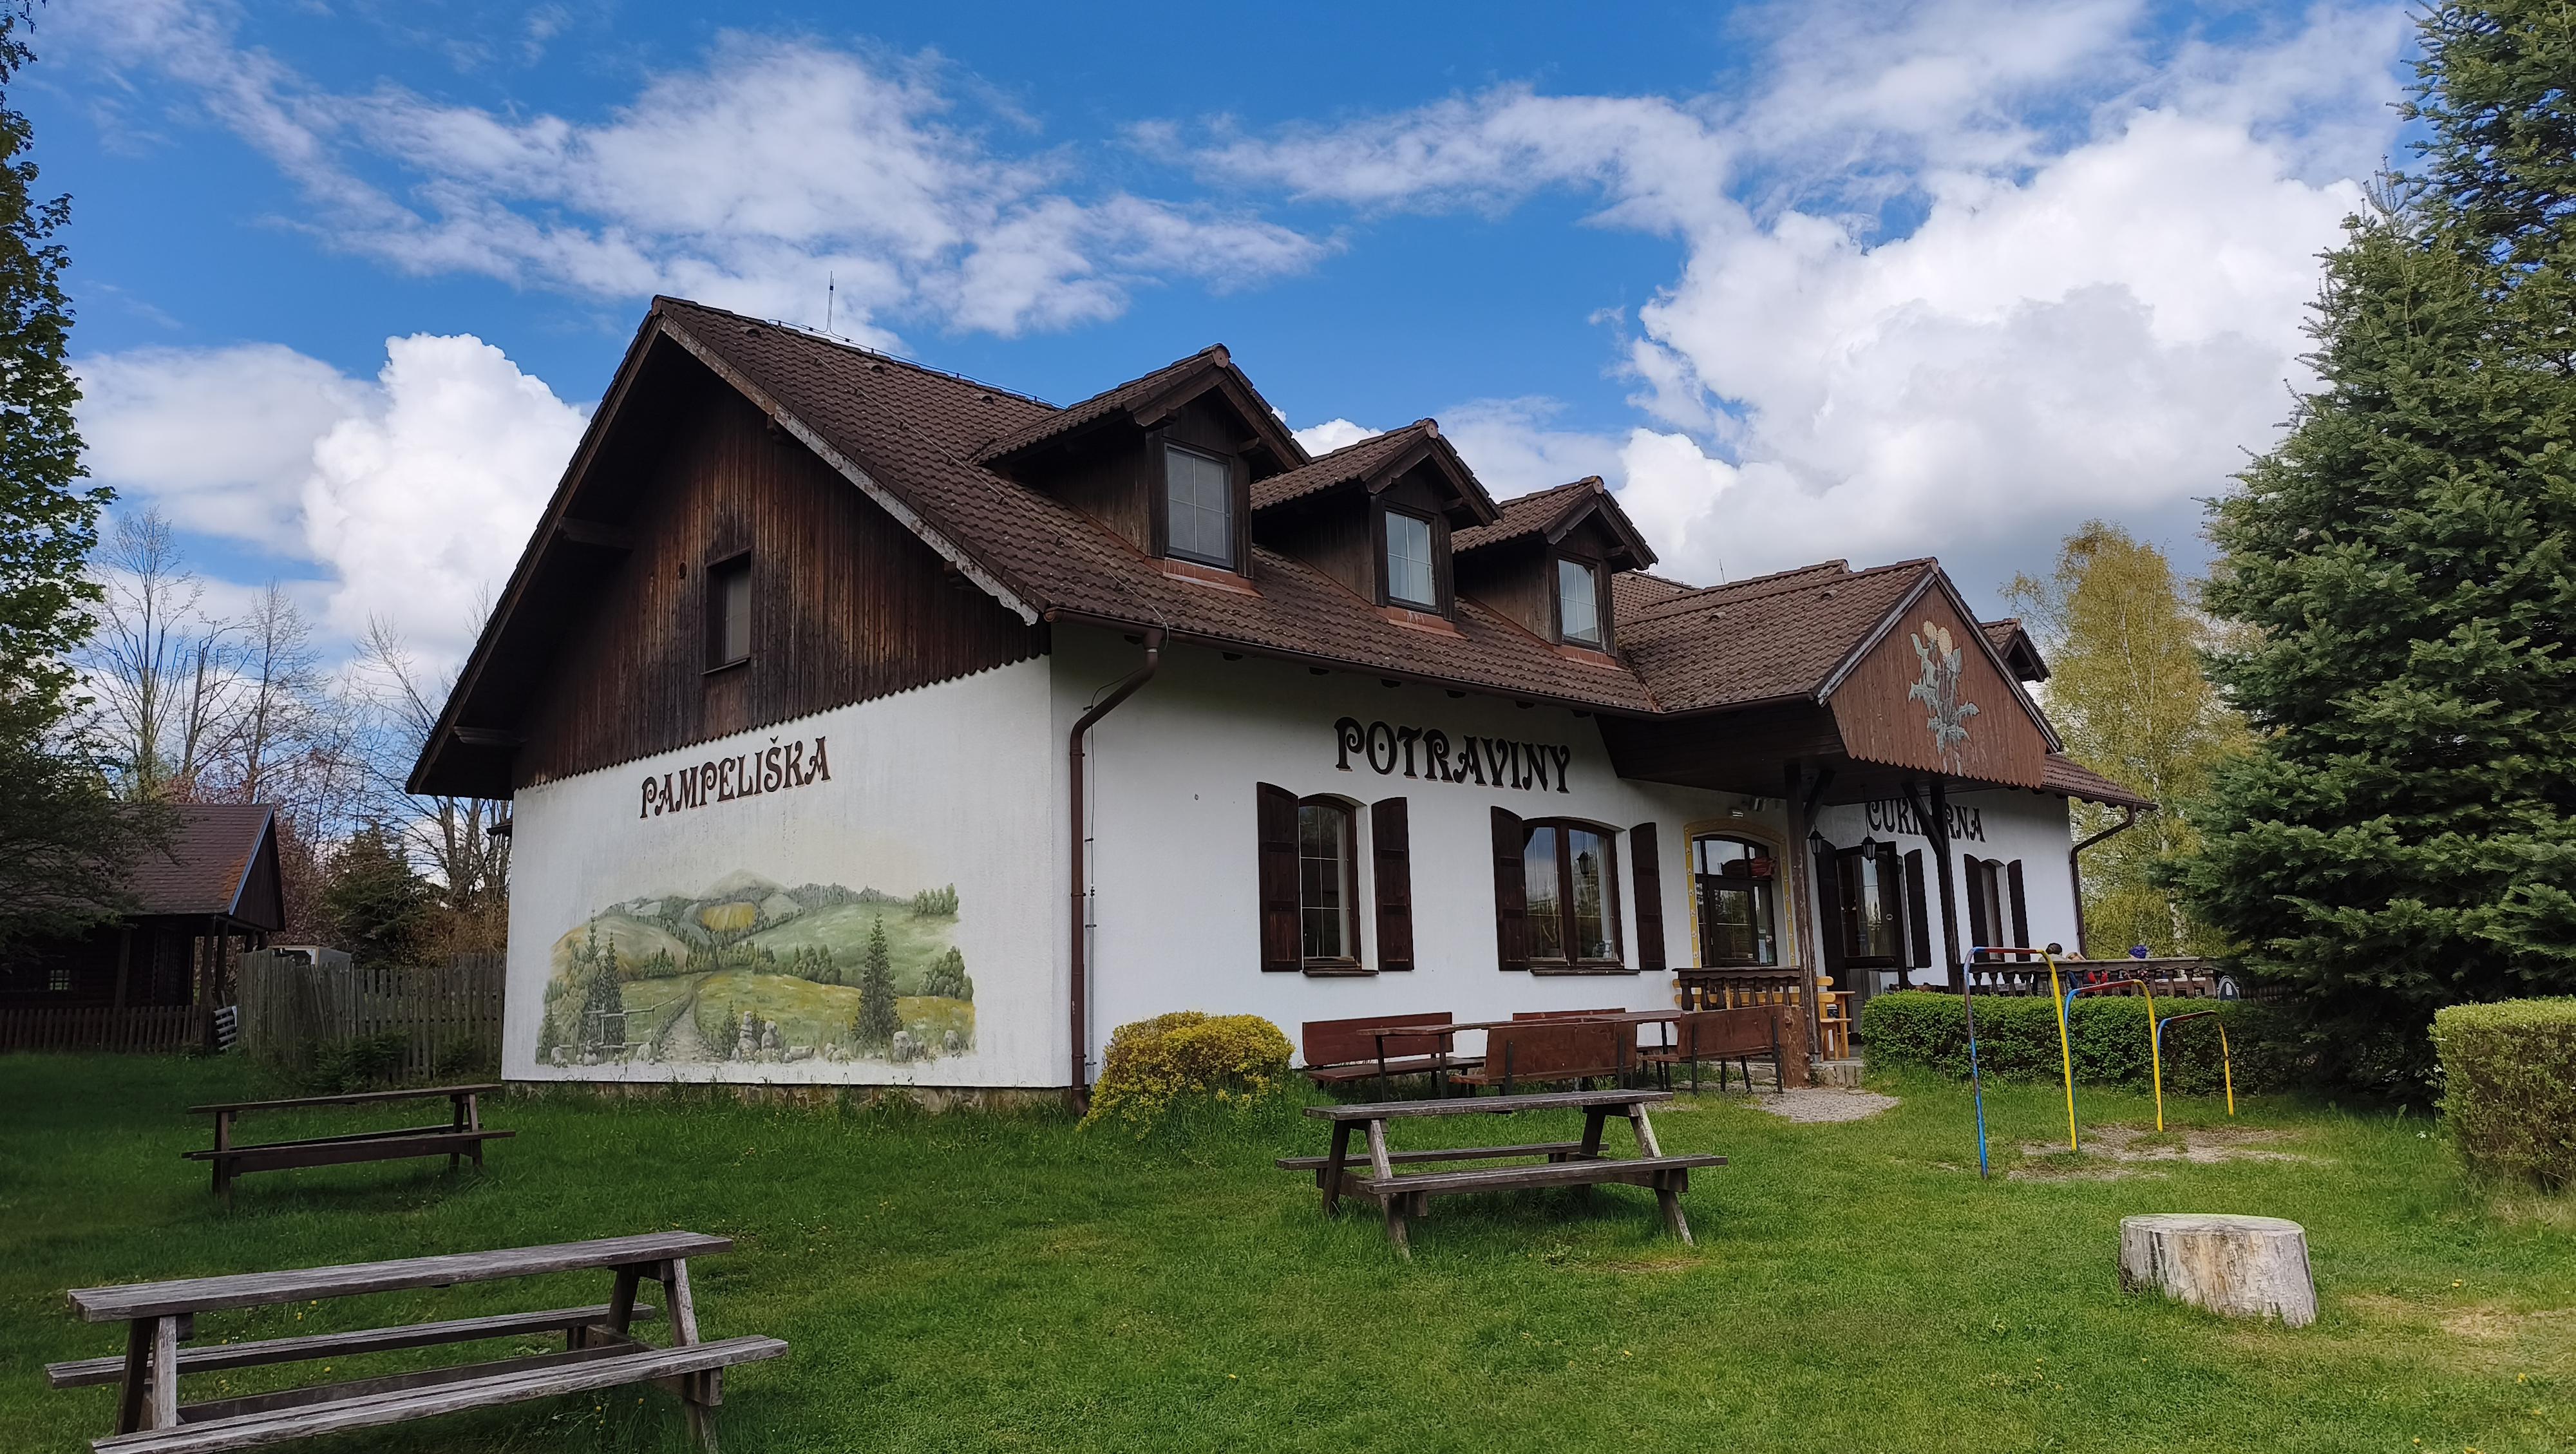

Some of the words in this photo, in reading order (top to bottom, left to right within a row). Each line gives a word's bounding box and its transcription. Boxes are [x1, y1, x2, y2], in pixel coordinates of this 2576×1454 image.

[640, 735, 831, 819] PAMPELIŠKA
[1334, 716, 1570, 793] POTRAVINY
[1868, 797, 1985, 843] CUKRNA
